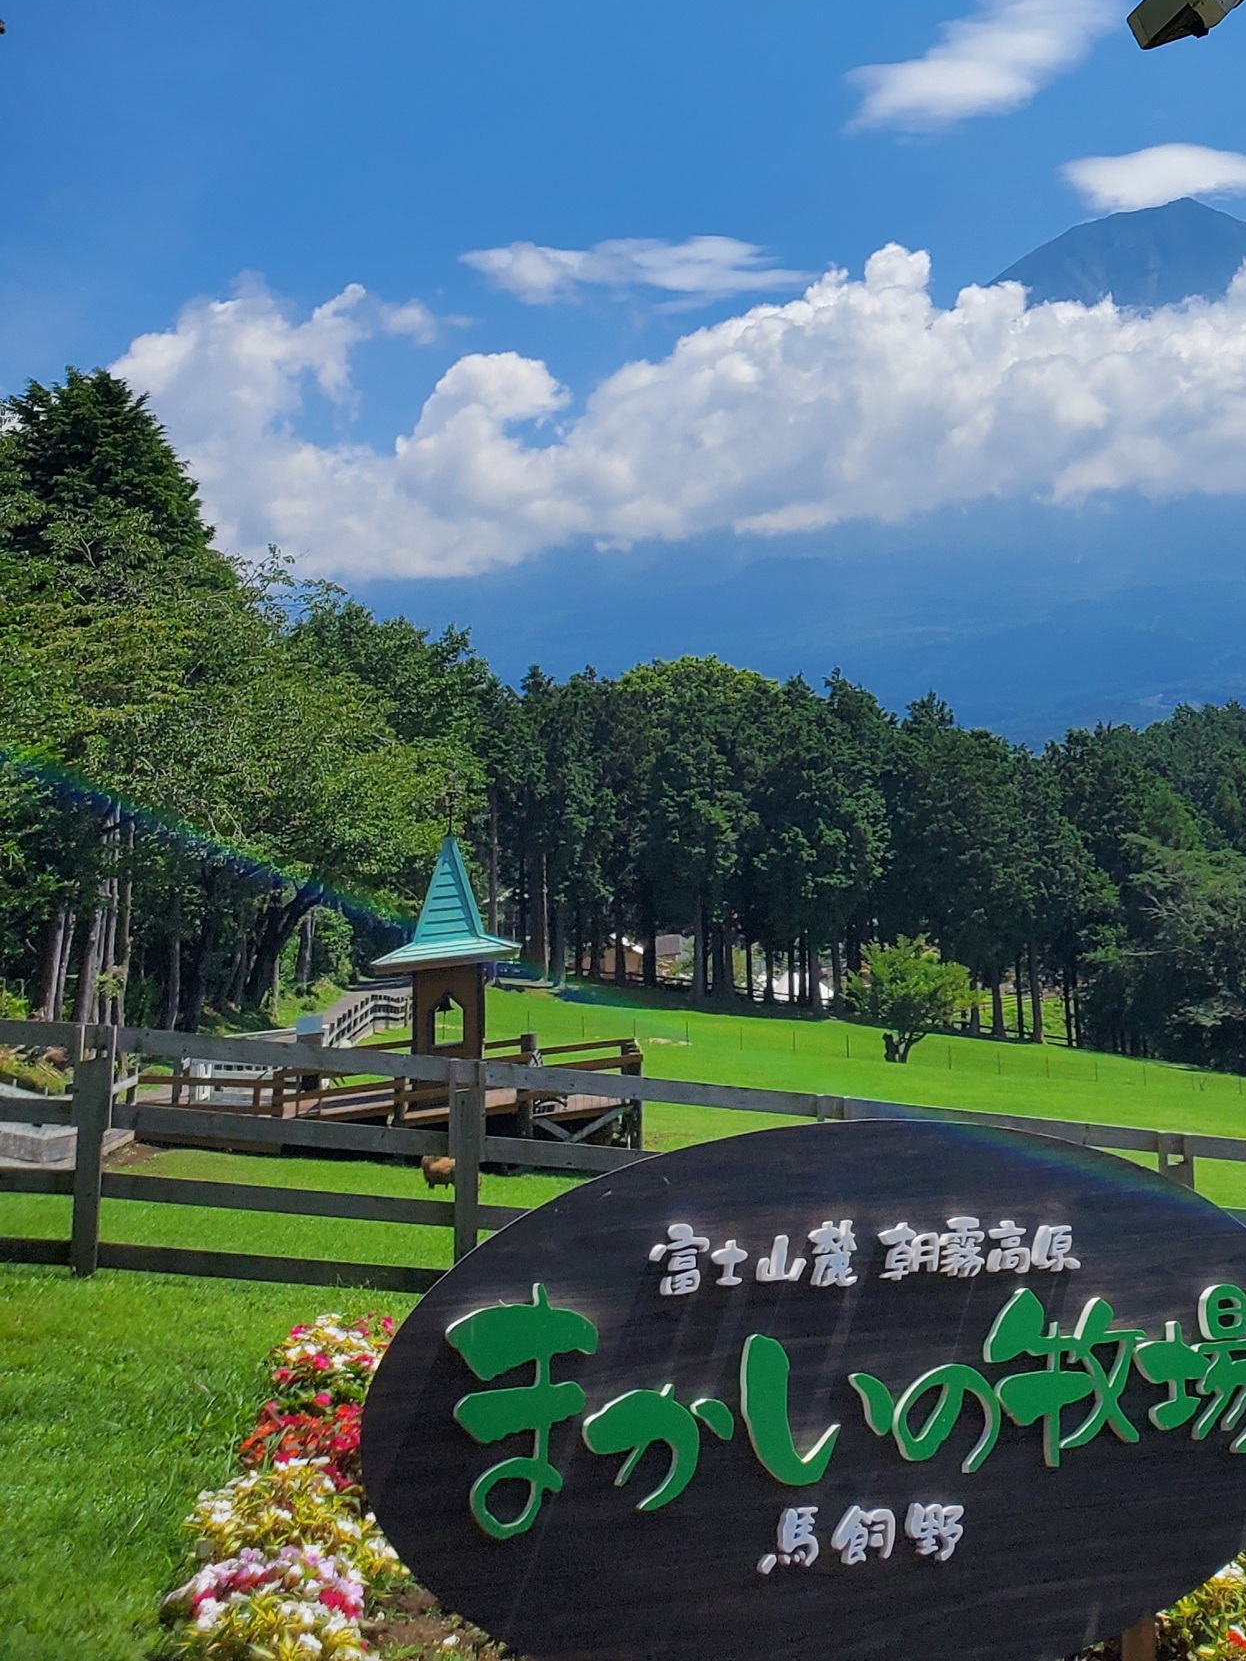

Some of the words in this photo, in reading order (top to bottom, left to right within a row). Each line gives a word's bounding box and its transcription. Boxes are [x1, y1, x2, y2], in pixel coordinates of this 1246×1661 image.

[649, 1220, 859, 1296] 富士山麓
[878, 1216, 1081, 1280] 朝霧高原
[756, 1502, 965, 1575] 馬飼野
